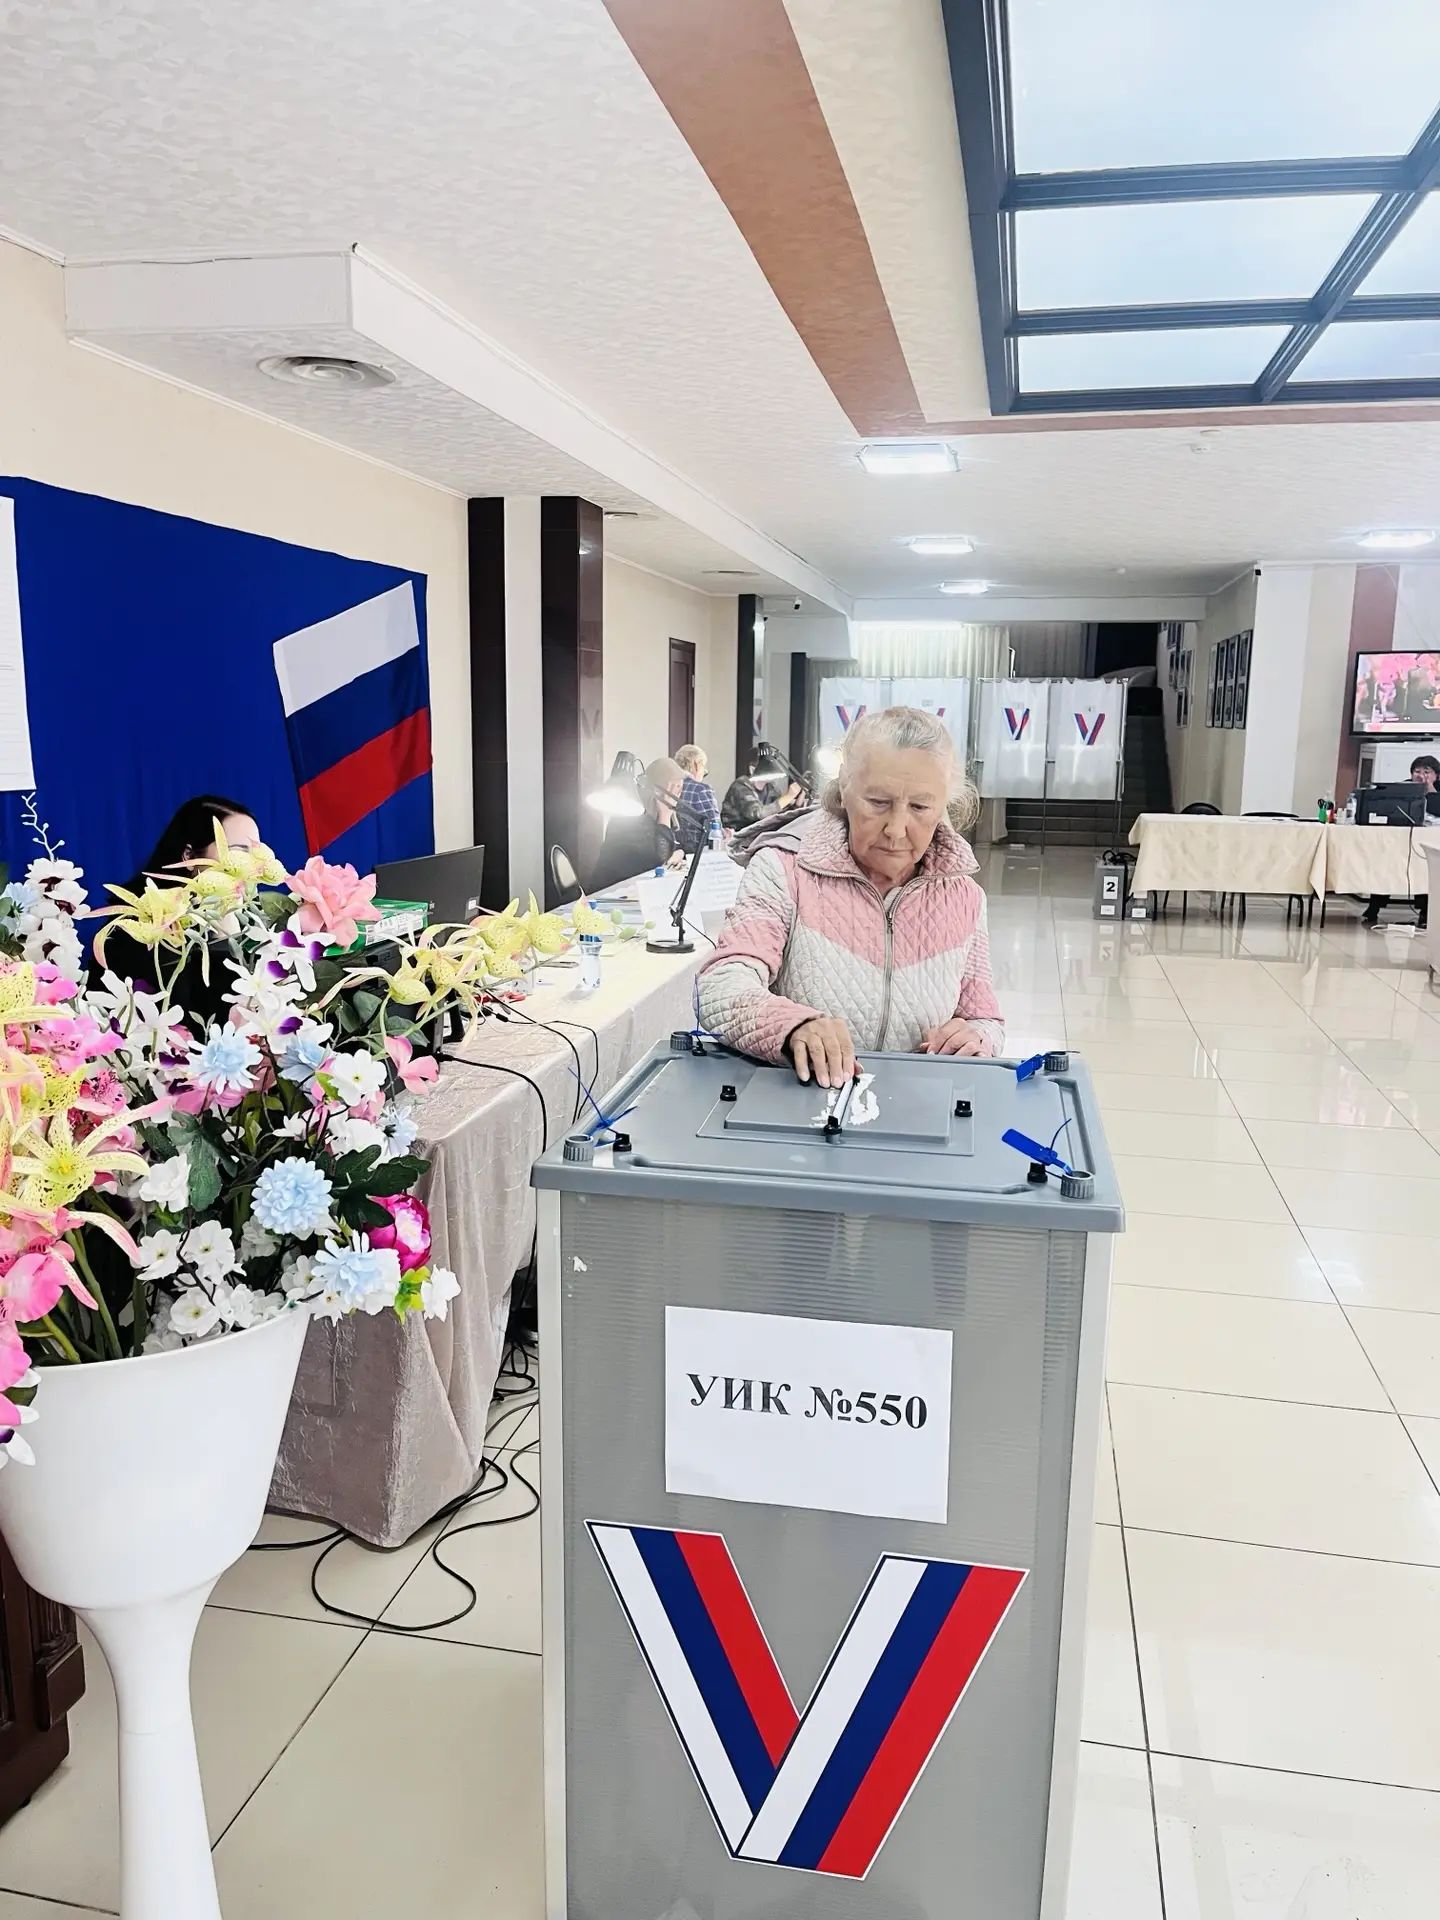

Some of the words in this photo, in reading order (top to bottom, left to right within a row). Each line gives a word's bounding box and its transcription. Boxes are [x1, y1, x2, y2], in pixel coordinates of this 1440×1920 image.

[1003, 706, 1031, 742] V
[1073, 711, 1107, 746] V
[1105, 881, 1116, 893] 2
[685, 1372, 792, 1416] УИК
[804, 1385, 928, 1430] №550
[584, 1518, 1030, 1881] V
